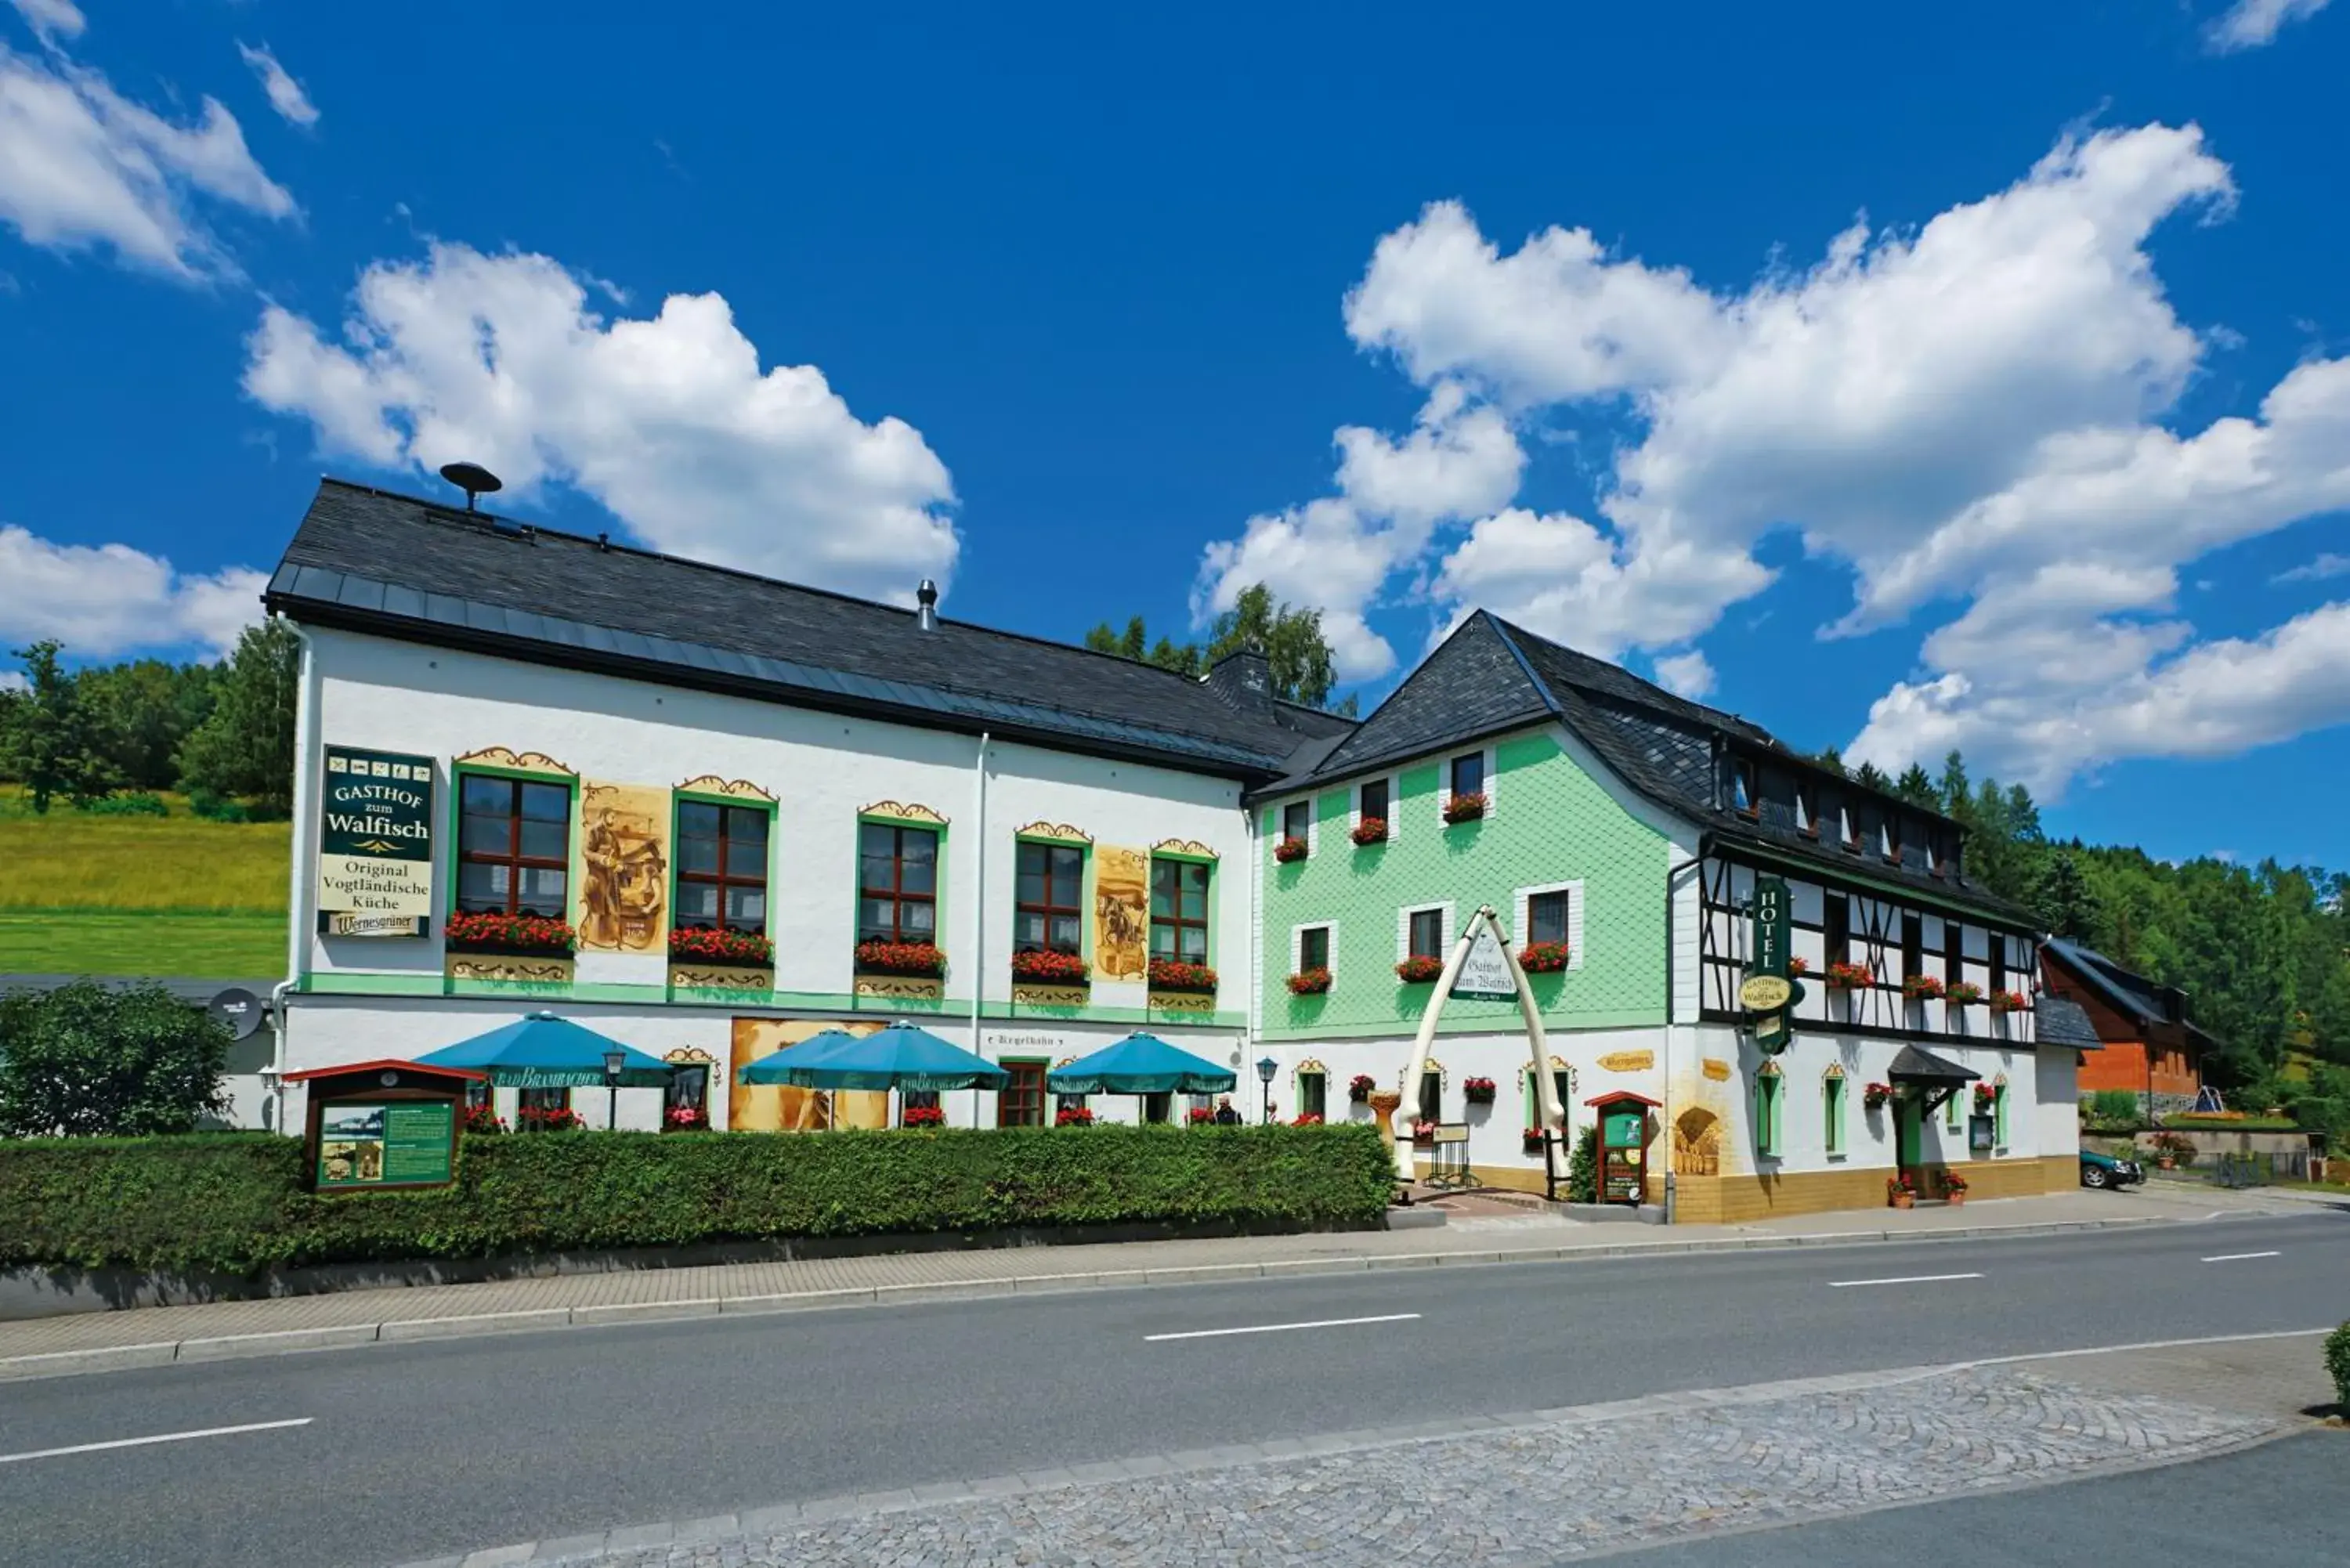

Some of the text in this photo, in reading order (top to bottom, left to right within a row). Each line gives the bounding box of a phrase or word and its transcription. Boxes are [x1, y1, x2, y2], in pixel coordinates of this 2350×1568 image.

[334, 784, 423, 808] GASTHOF
[363, 803, 393, 814] zum
[327, 813, 429, 839] Walfisch
[345, 861, 408, 878] Original
[324, 876, 428, 894] Vogtländische
[352, 895, 400, 909] Küche
[1760, 891, 1777, 969] HOTEL
